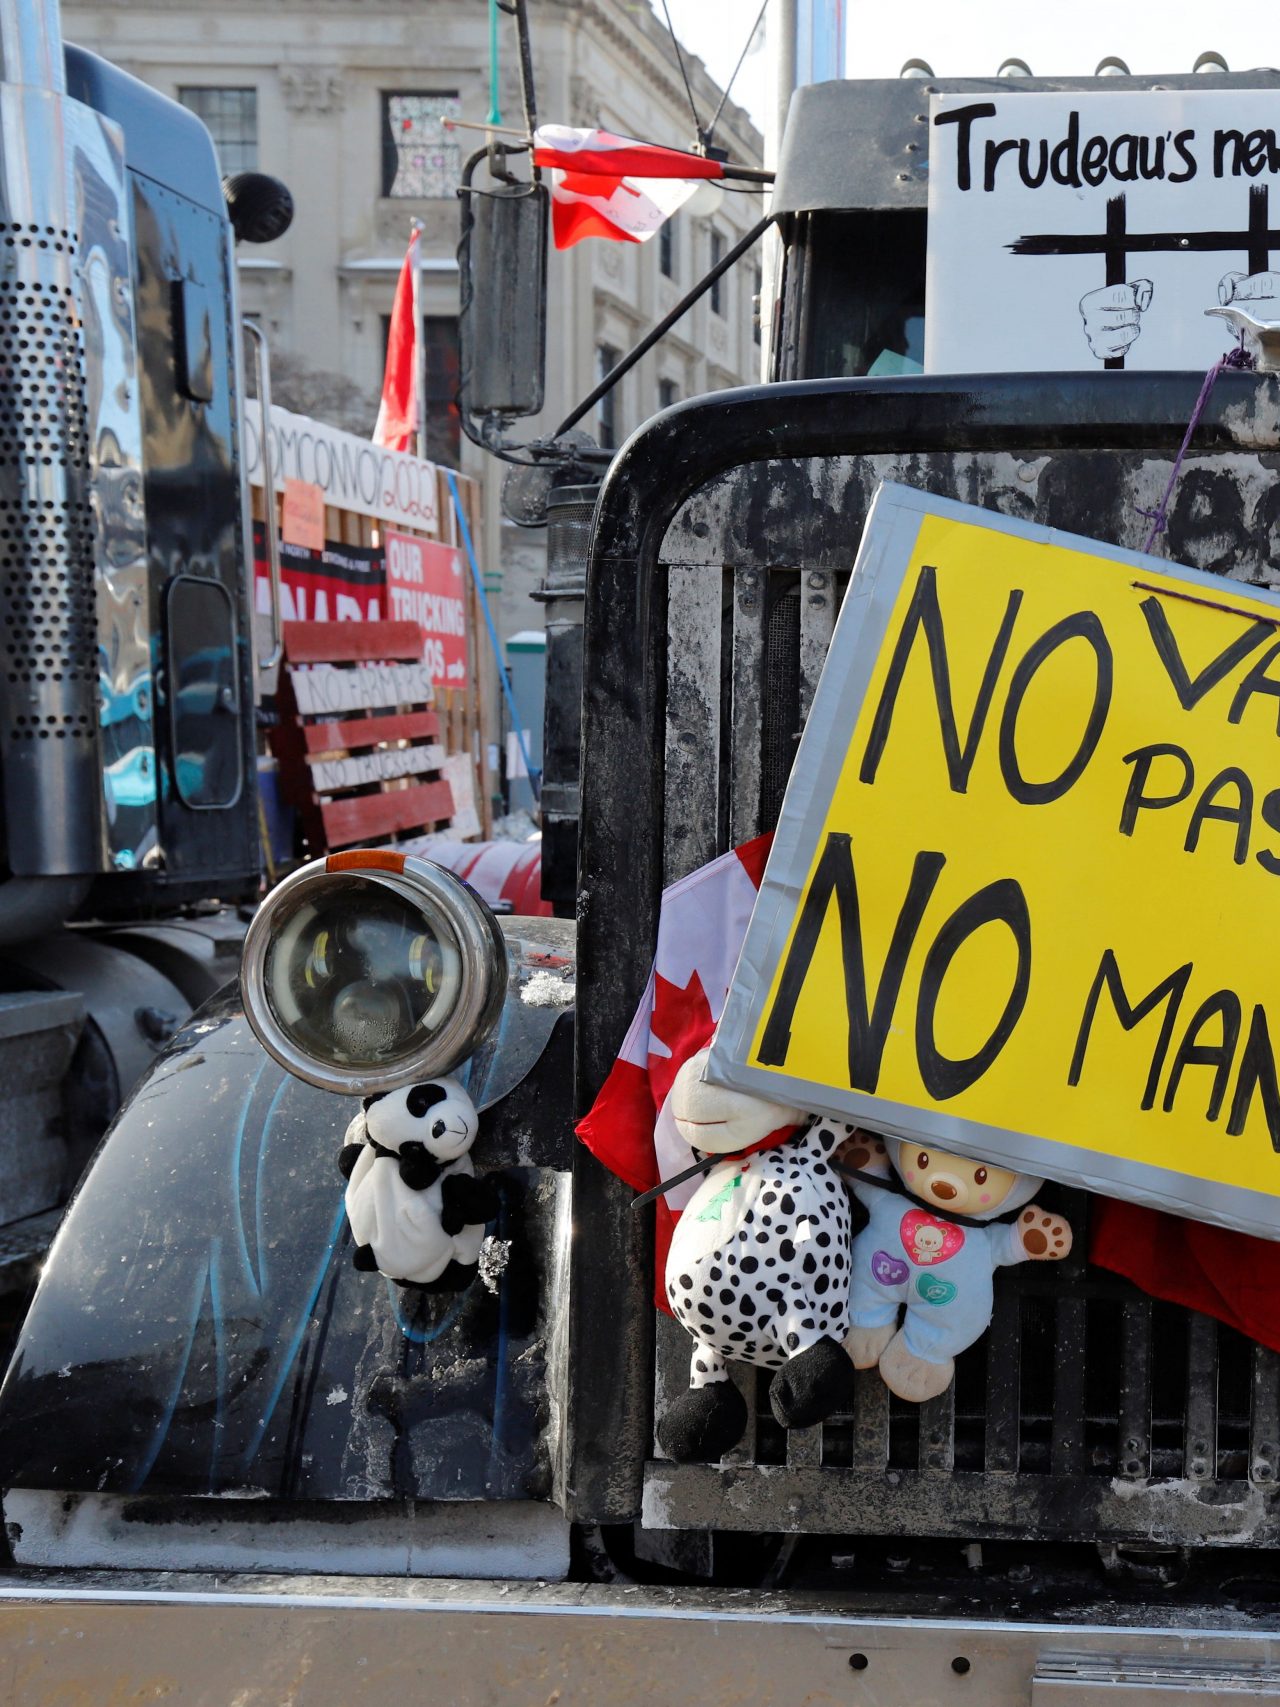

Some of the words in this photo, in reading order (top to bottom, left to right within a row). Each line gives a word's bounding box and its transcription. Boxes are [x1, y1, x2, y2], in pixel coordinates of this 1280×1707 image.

[934, 102, 1197, 192] Trudeau's
[389, 538, 424, 583] OUR
[390, 585, 466, 637] TRUCKING
[307, 671, 342, 711] NO
[859, 566, 1112, 806] NO
[321, 759, 346, 789] NO
[756, 832, 1032, 1101] NO
